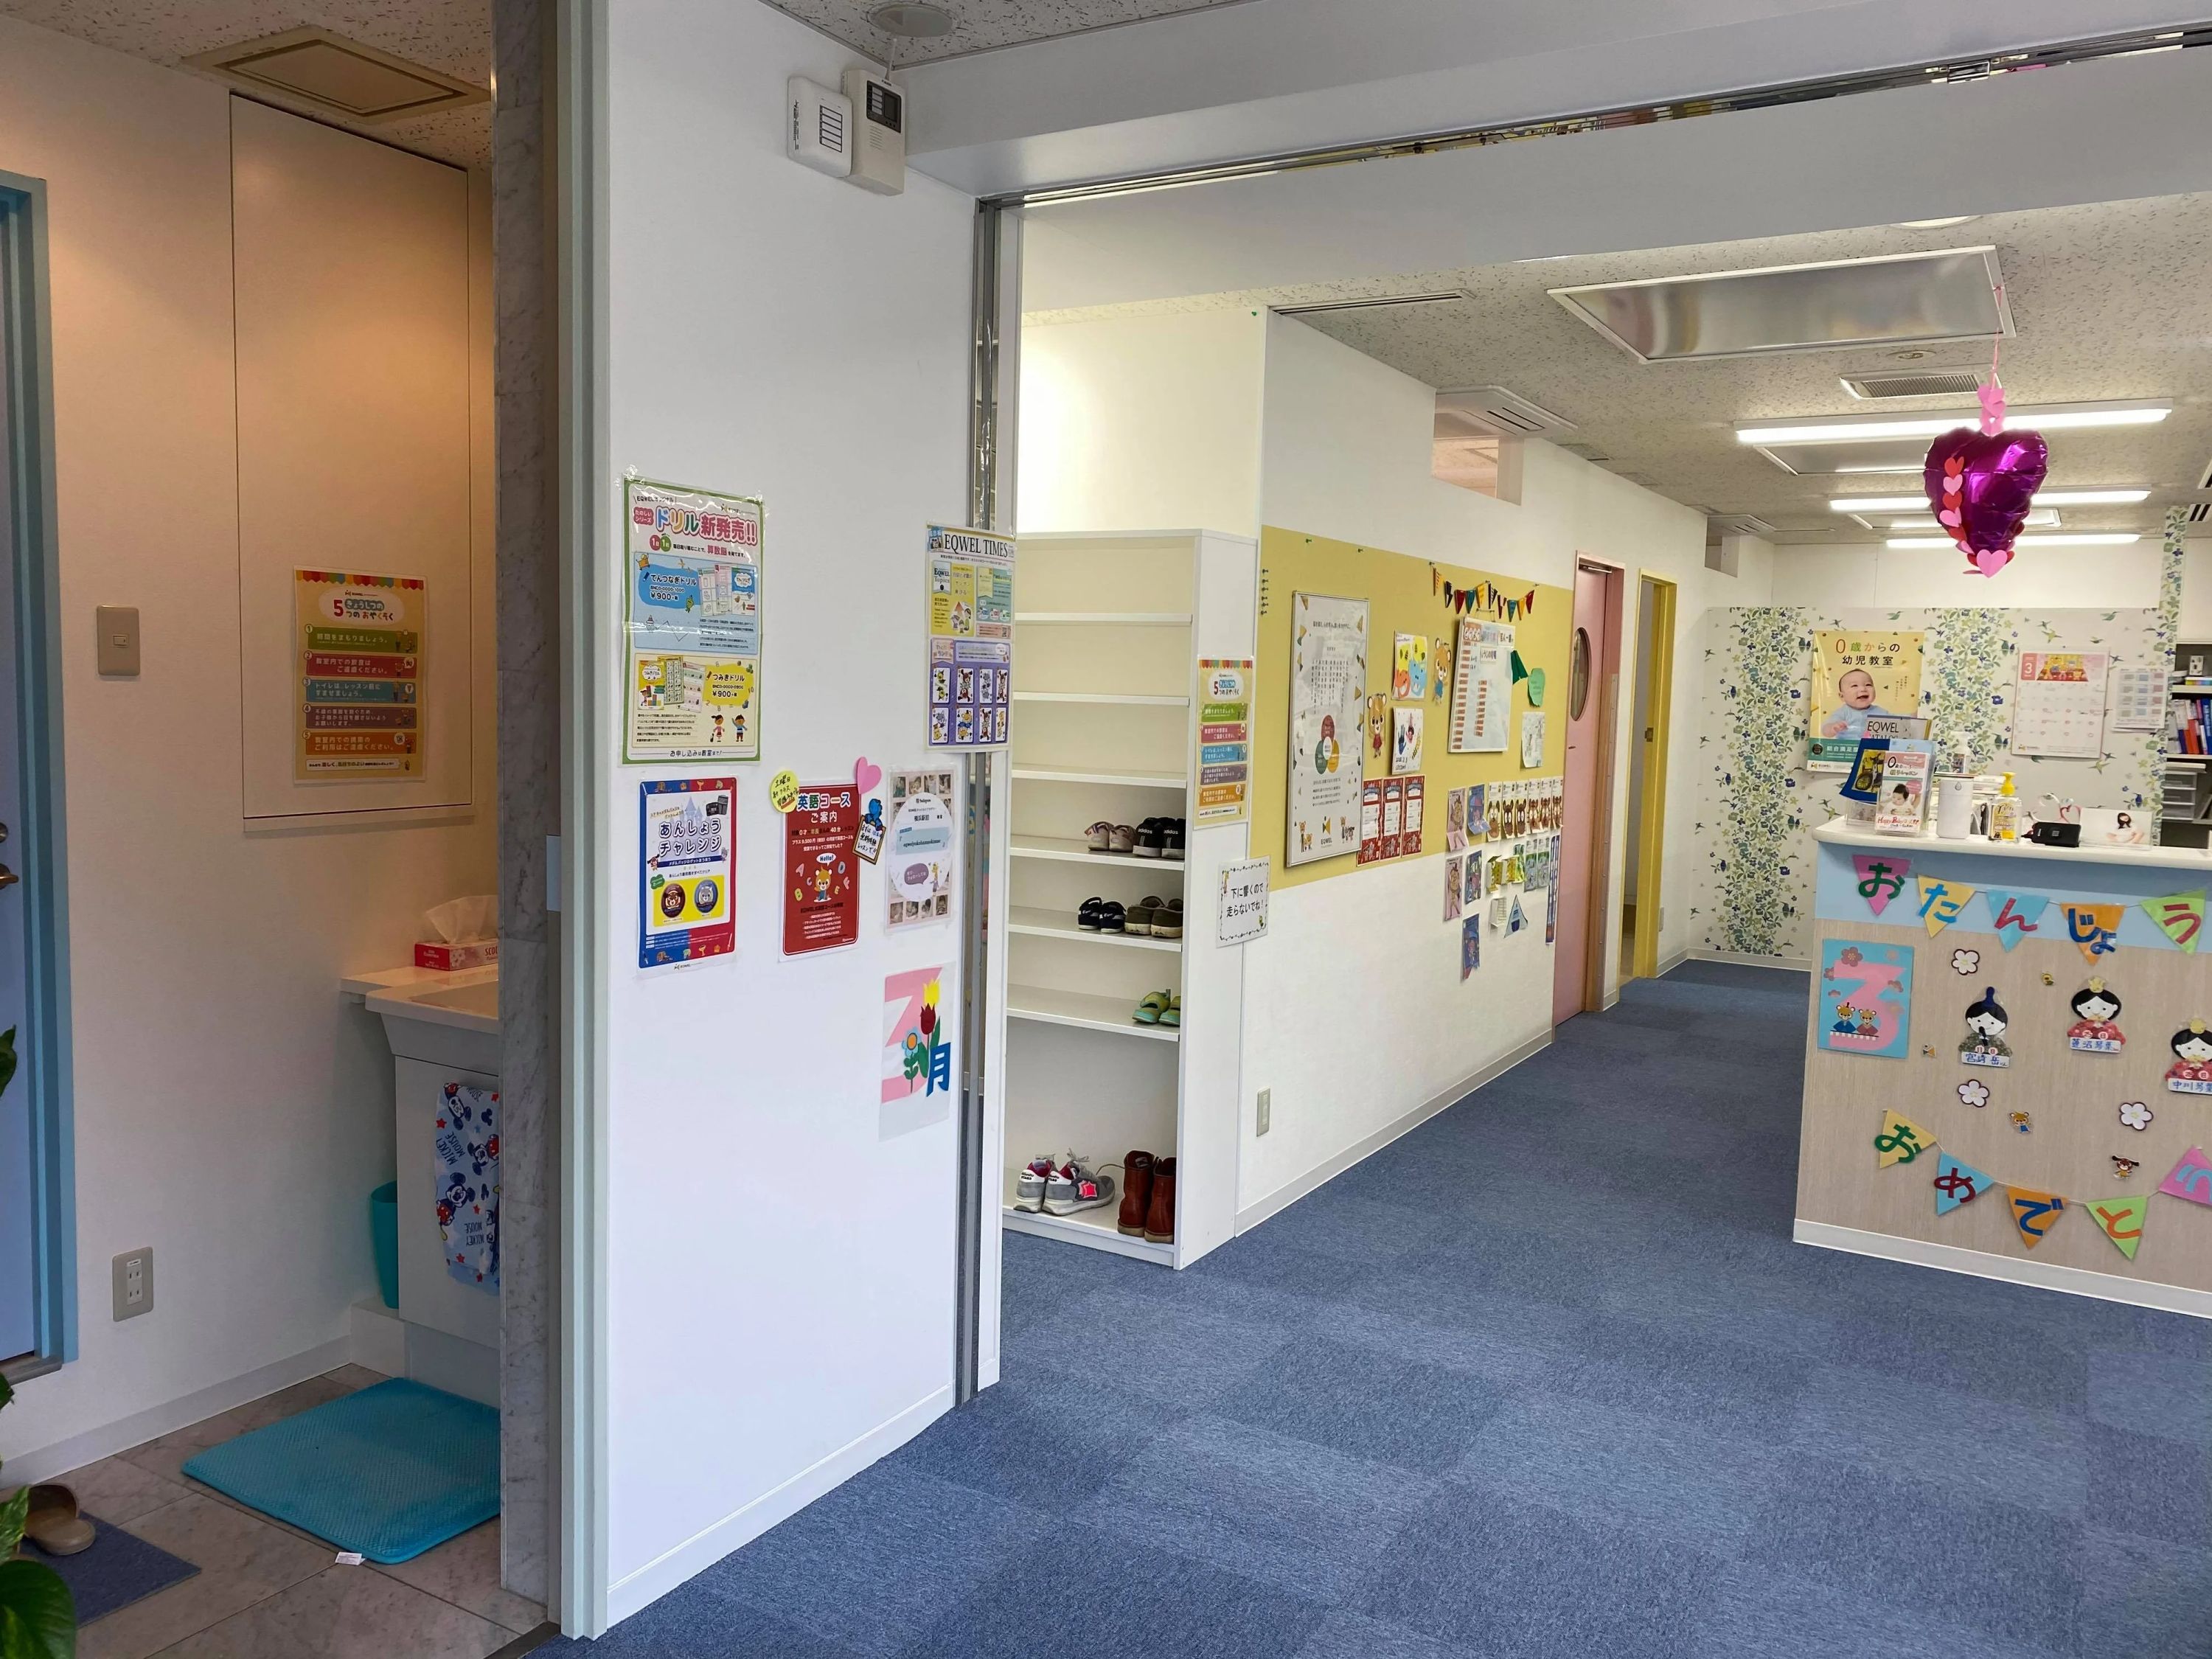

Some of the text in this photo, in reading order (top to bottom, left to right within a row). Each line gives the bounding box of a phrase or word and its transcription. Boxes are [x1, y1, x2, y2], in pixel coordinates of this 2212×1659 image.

[945, 534, 1009, 558] EQWEL TIMES
[650, 574, 697, 586] てんつなぎドリル
[333, 599, 344, 616] 5
[1836, 639, 1900, 655] 0歳からの
[1842, 655, 1893, 667] 幼児教室
[2025, 662, 2033, 674] 3
[712, 673, 745, 683] つみきドリル
[1214, 681, 1219, 695] 5
[1868, 720, 1899, 734] EQWEL
[797, 793, 851, 813] 英語コース
[811, 810, 838, 824] ご案内
[659, 818, 723, 839] あんしょう
[659, 835, 723, 858] チャレンジ
[1321, 837, 1333, 846] EQWEL
[820, 854, 834, 862] Hello!
[1231, 883, 1264, 900] 下に響くので
[1227, 899, 1265, 918] 走らないでね!
[436, 1137, 459, 1166] MICKEY
[445, 1131, 466, 1158] MOUSE
